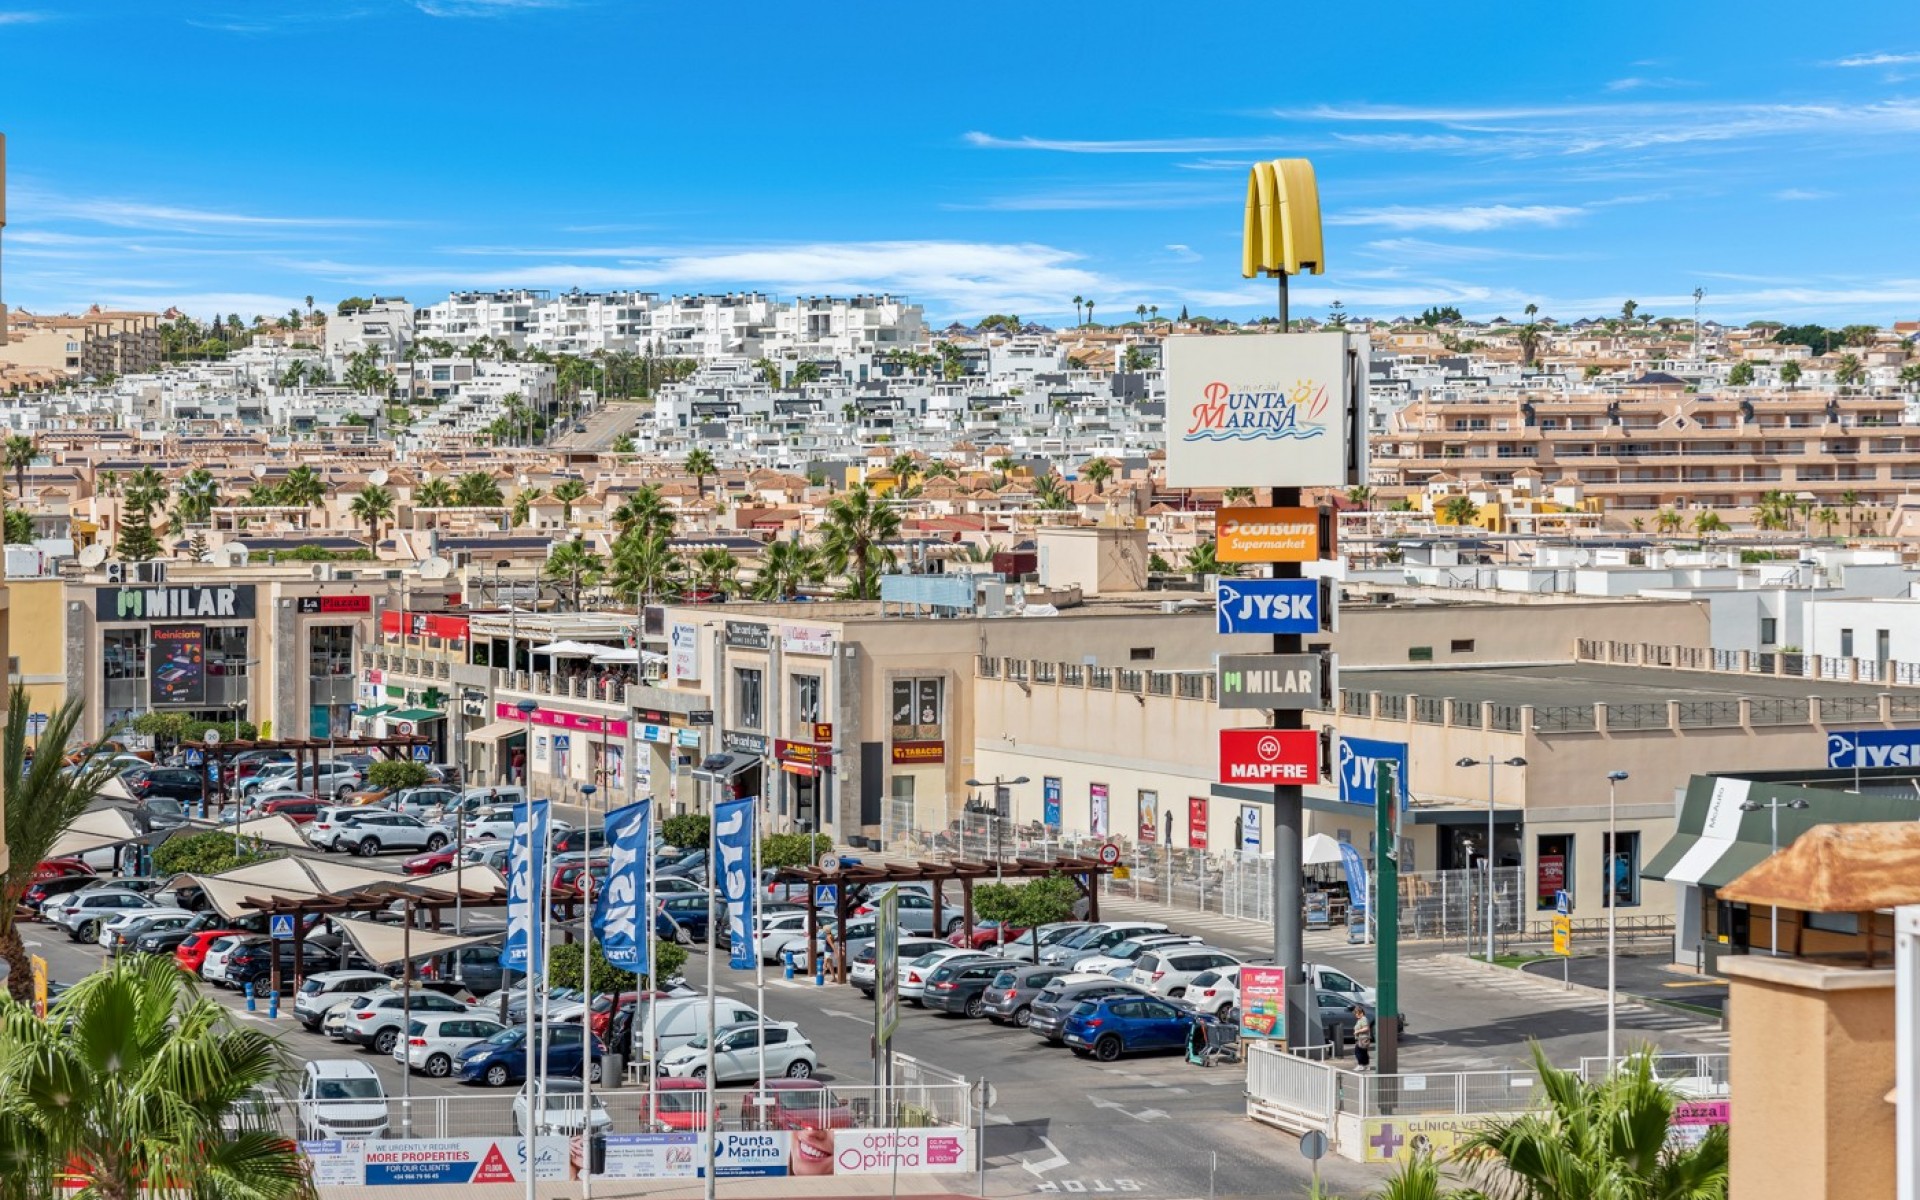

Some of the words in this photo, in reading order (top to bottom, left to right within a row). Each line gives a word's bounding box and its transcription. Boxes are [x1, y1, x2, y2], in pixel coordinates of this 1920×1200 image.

[1204, 382, 1287, 410] PUNTA
[1188, 403, 1297, 433] MARINA
[1240, 521, 1316, 536] consum
[1231, 537, 1306, 551] Supermarket
[146, 588, 235, 616] MILAR
[303, 598, 318, 608] La
[1238, 595, 1313, 619] JYSK
[1246, 670, 1312, 693] MILAR
[905, 747, 943, 756] TABACOS
[1231, 763, 1308, 778] MAPFRE
[1104, 850, 1115, 858] 20
[824, 859, 835, 867] 20
[1408, 1119, 1457, 1132] CLÍNICA
[729, 1136, 773, 1146] Punta
[864, 1133, 919, 1149] óptica
[367, 1153, 399, 1162] MORE
[402, 1151, 470, 1161] PROPERTIES
[729, 1145, 780, 1157] Marina
[839, 1148, 919, 1170] Optima
[1037, 1180, 1142, 1192] STOP
